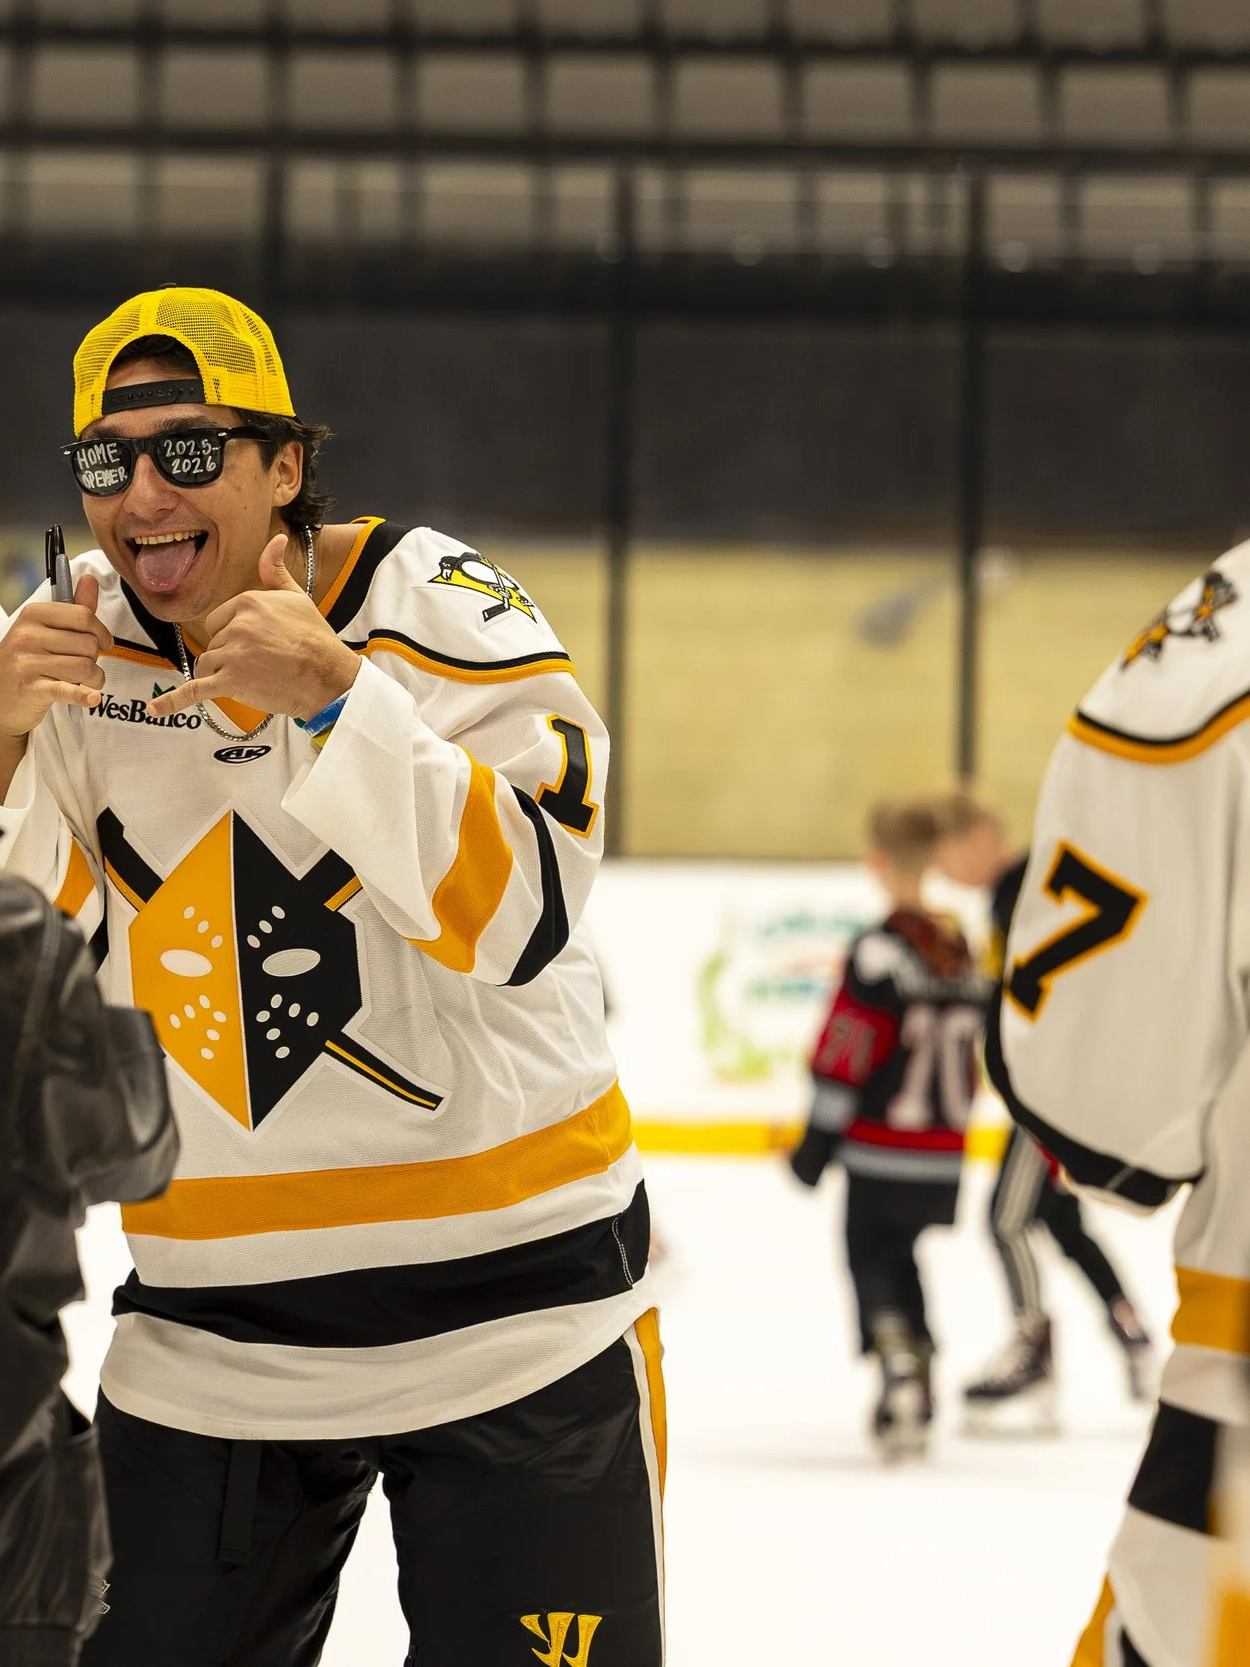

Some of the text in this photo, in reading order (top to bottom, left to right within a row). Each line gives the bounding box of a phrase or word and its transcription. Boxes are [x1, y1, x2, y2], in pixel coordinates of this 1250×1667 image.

[76, 442, 120, 470] HOME
[163, 438, 222, 458] 2025-
[81, 465, 128, 489] OPENER
[171, 456, 217, 475] 2026
[535, 713, 600, 840] 1
[1001, 838, 1149, 1023] 7
